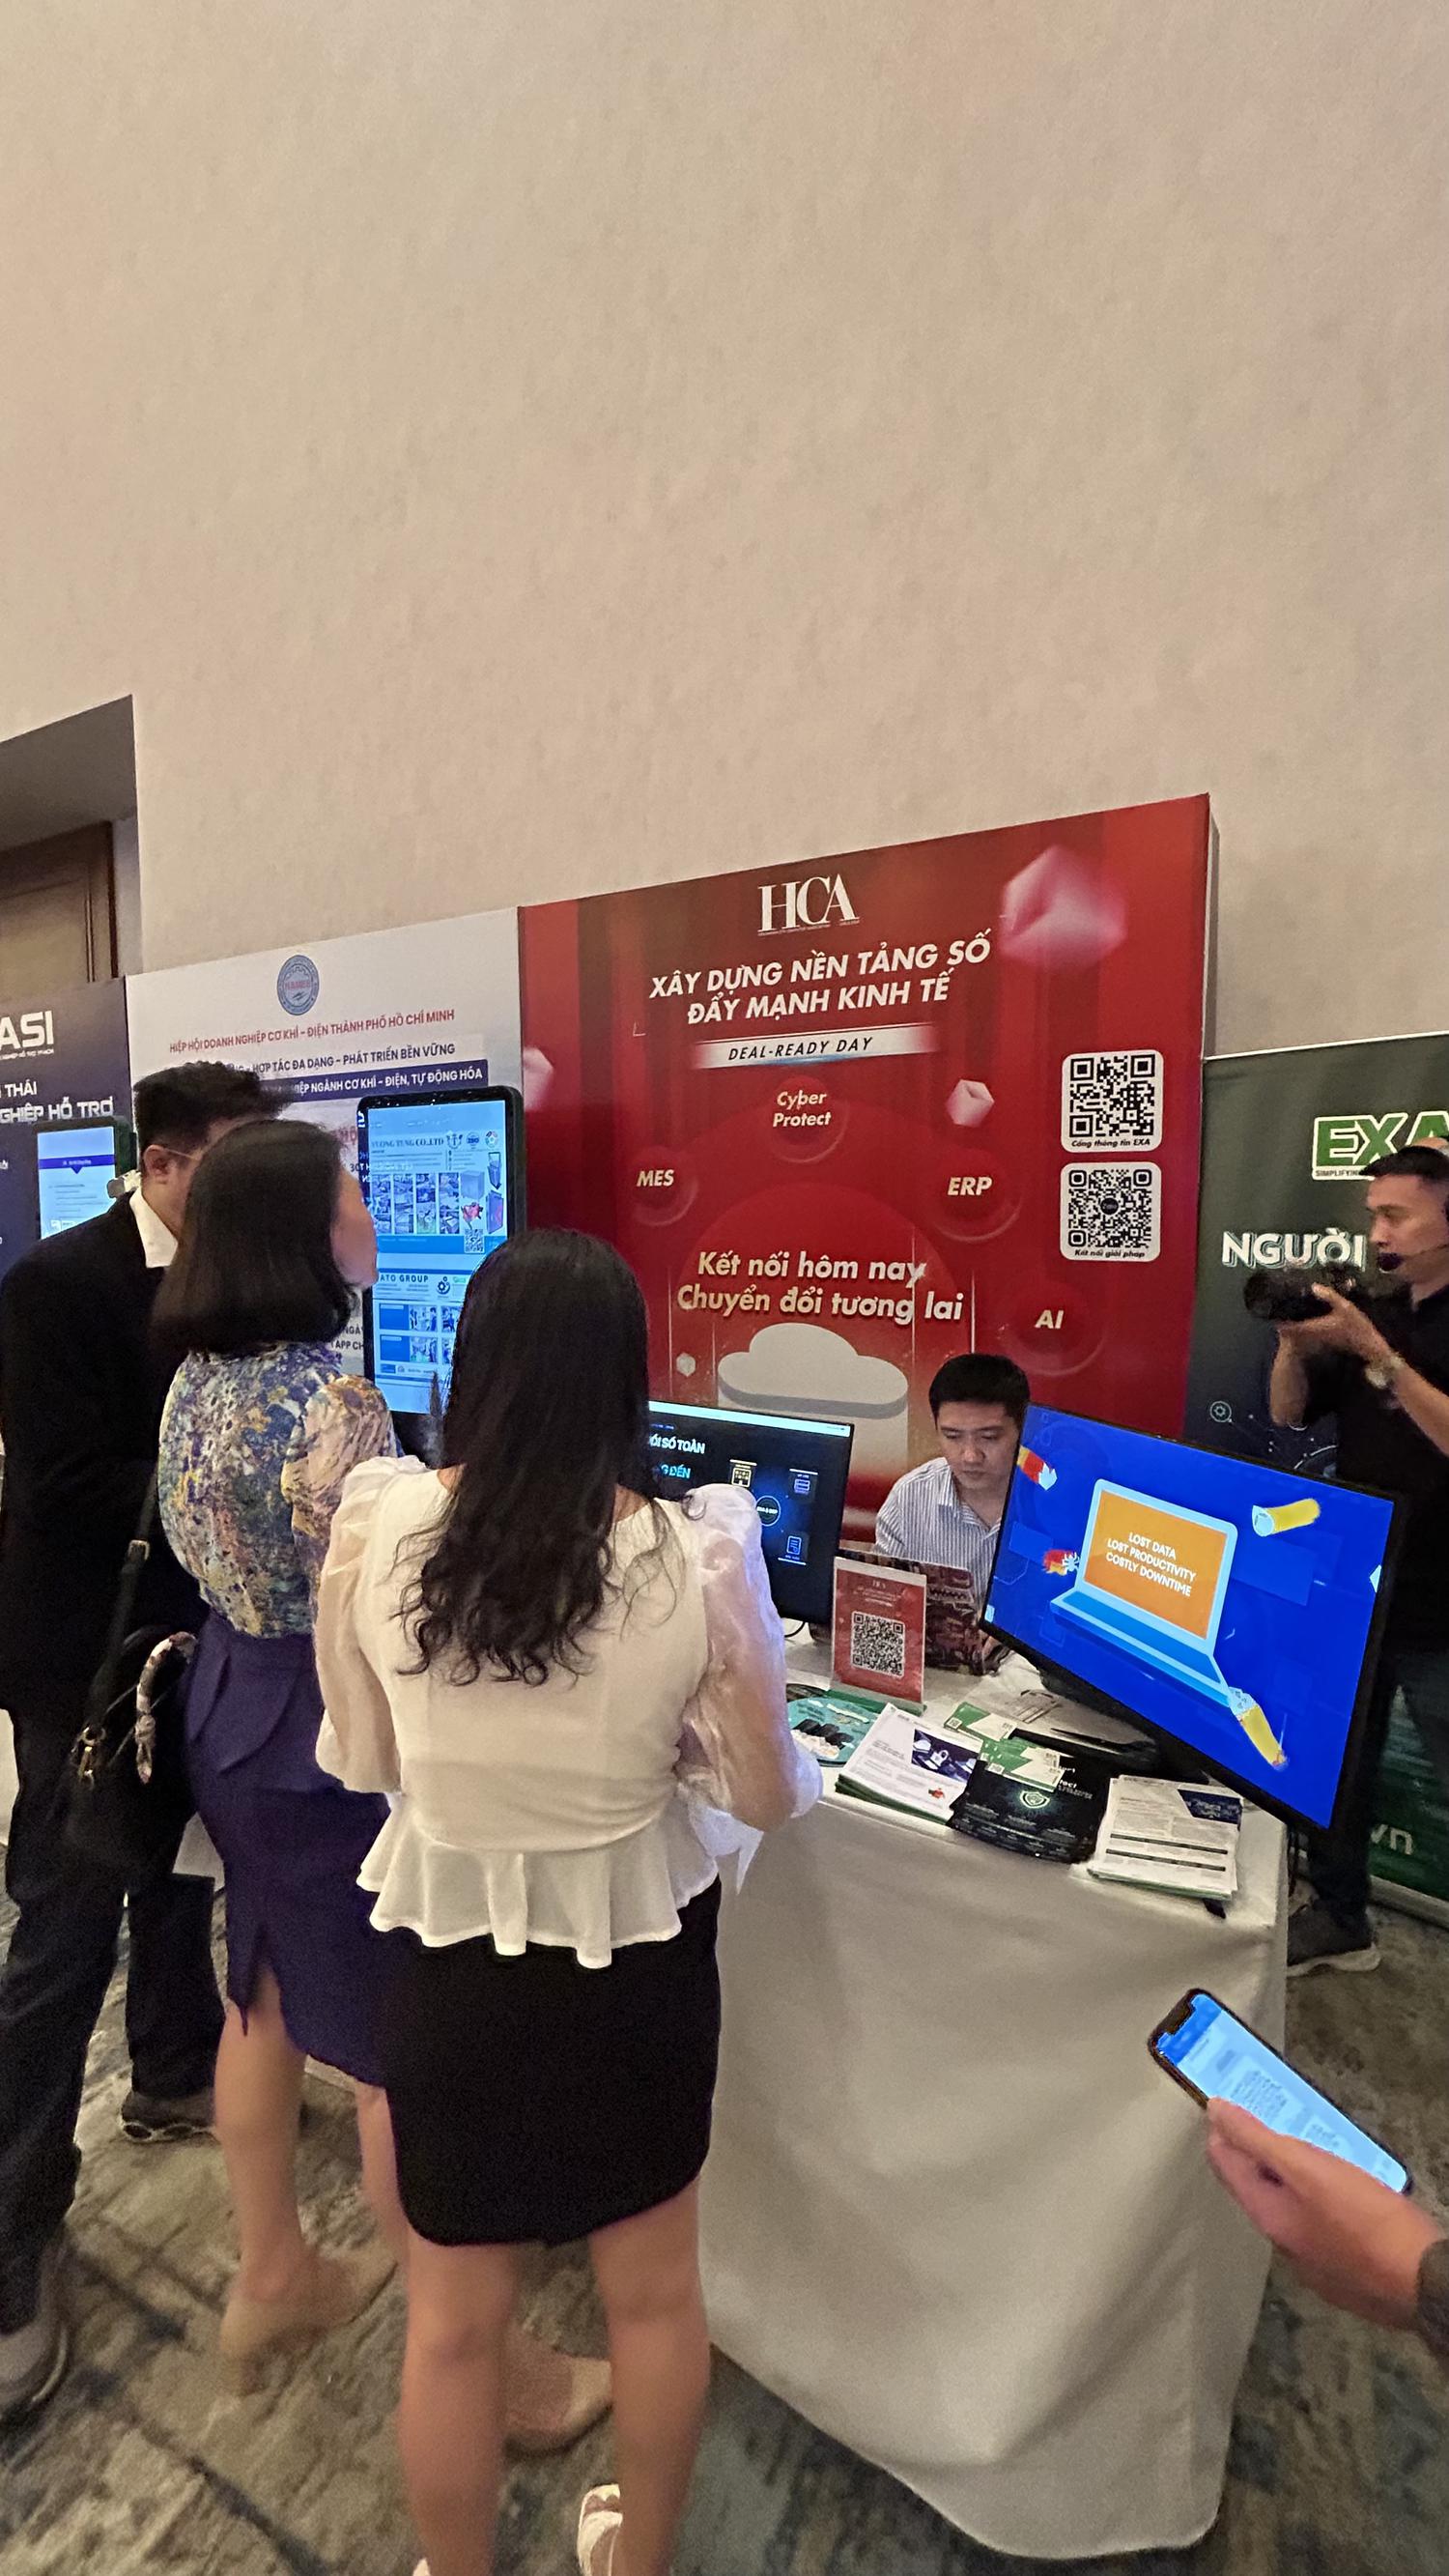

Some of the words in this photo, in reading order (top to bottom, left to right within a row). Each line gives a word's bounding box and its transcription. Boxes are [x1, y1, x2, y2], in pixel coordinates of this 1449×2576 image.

[757, 873, 860, 932] HCA
[649, 970, 701, 998] XÂY
[707, 962, 782, 995] DỰNG
[790, 950, 849, 983] NỀN
[858, 941, 938, 975] TẢNG
[947, 928, 991, 965] SỐ
[688, 991, 741, 1024] ĐẨY
[746, 988, 830, 1021] MẠNH
[838, 981, 911, 1010] KINH
[920, 967, 954, 1002] TẾ
[0, 1011, 54, 1050] ASI
[170, 1041, 186, 1054] HIỆP
[187, 1038, 203, 1052] HỘI
[204, 1036, 234, 1049] DOANH
[235, 1030, 267, 1045] NGHIỆP
[283, 1025, 298, 1040] KHÍ
[307, 1021, 328, 1039] ĐIỆN
[331, 1019, 363, 1035] THÀNH
[365, 1015, 386, 1030] PHỐ
[388, 1012, 403, 1027] HỒ
[406, 1009, 424, 1025] CHÍ
[426, 1009, 454, 1024] MINH
[273, 1058, 291, 1072] TÁC
[292, 1058, 305, 1070] ĐA
[309, 1056, 333, 1070] DẠNG
[343, 1050, 368, 1066] PHÁT
[371, 1045, 398, 1062] TRIỂN
[400, 1044, 420, 1059] BỀN
[422, 1043, 455, 1057] VỮNG
[728, 1041, 829, 1061] DEAL-READY
[836, 1036, 873, 1052] DAY
[5, 1079, 37, 1098] THÁI
[311, 1078, 343, 1093] NGÀNH
[345, 1078, 359, 1090] CƠ
[360, 1074, 376, 1089] KHÍ
[412, 1072, 426, 1085] TỰ
[427, 1070, 457, 1084] ĐỘNG
[459, 1066, 483, 1079] HÓA
[48, 1096, 72, 1120] HỖ
[777, 1090, 827, 1110] Cyber
[773, 1111, 831, 1128] Protect
[637, 1169, 674, 1188] MES
[948, 1176, 993, 1196] ERP
[1222, 1227, 1366, 1271] NGƯỜI
[399, 1274, 429, 1283] GROUP
[697, 1249, 741, 1275] Kết
[748, 1250, 790, 1277] nối
[797, 1250, 859, 1279] hôm
[868, 1261, 927, 1289] nay
[677, 1283, 770, 1317] Chuyển
[780, 1285, 823, 1314] đổi
[832, 1292, 915, 1325] tương
[924, 1291, 964, 1320] lai
[1035, 1309, 1064, 1330] AI
[1107, 1537, 1130, 1554] LOST
[1129, 1547, 1197, 1582] PRODUCTIVITY
[1128, 1531, 1151, 1549] LOST
[1151, 1541, 1177, 1560] DATA
[1106, 1552, 1140, 1573] COSTLY
[1140, 1565, 1192, 1597] DOWNTIME
